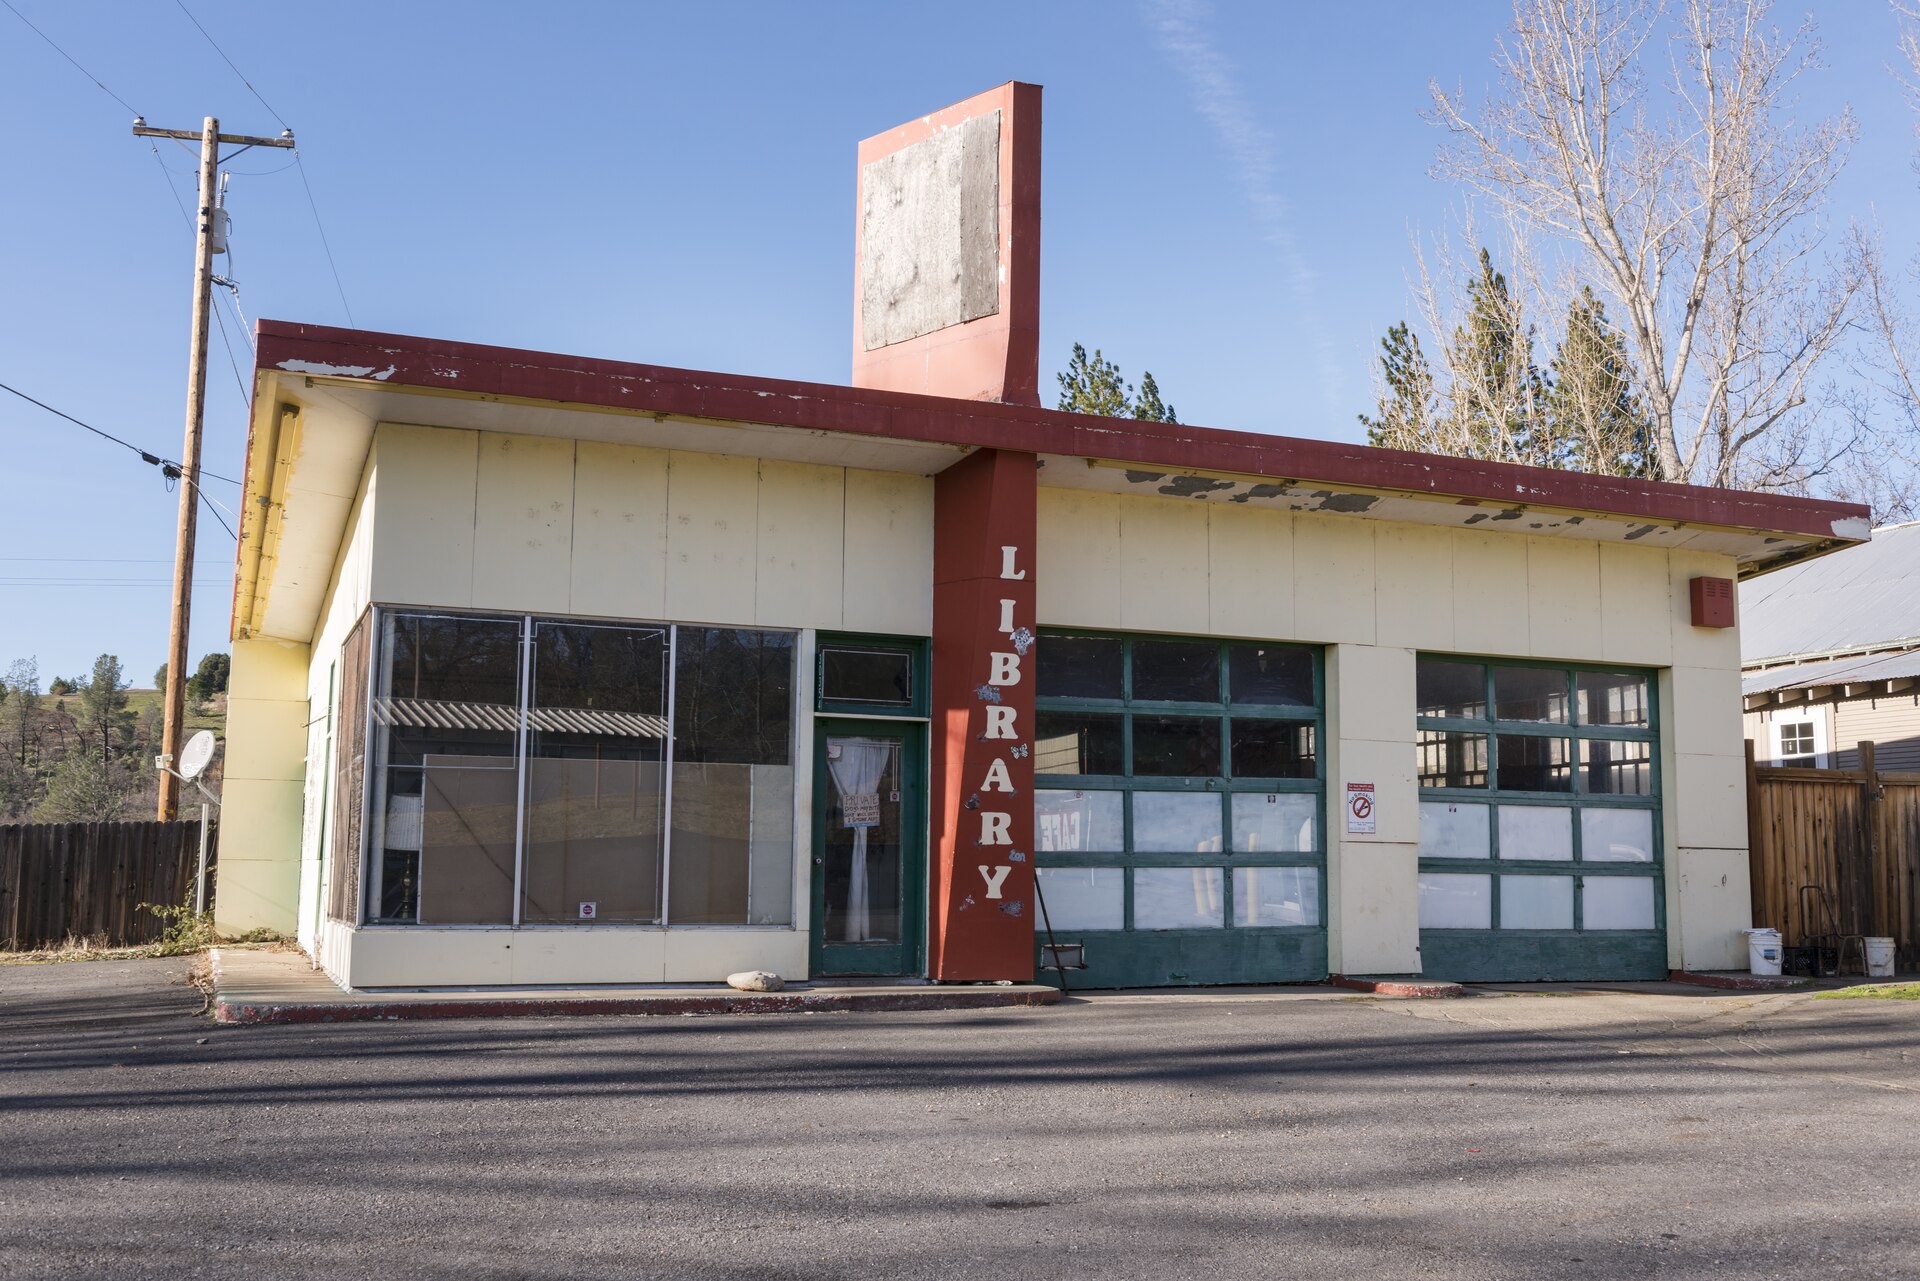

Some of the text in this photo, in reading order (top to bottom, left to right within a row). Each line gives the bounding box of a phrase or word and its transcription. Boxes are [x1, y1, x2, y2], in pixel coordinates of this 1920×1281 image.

[978, 545, 1026, 899] LIBRARY
[844, 795, 879, 806] PRIVATE
[1353, 792, 1374, 805] Smoking
